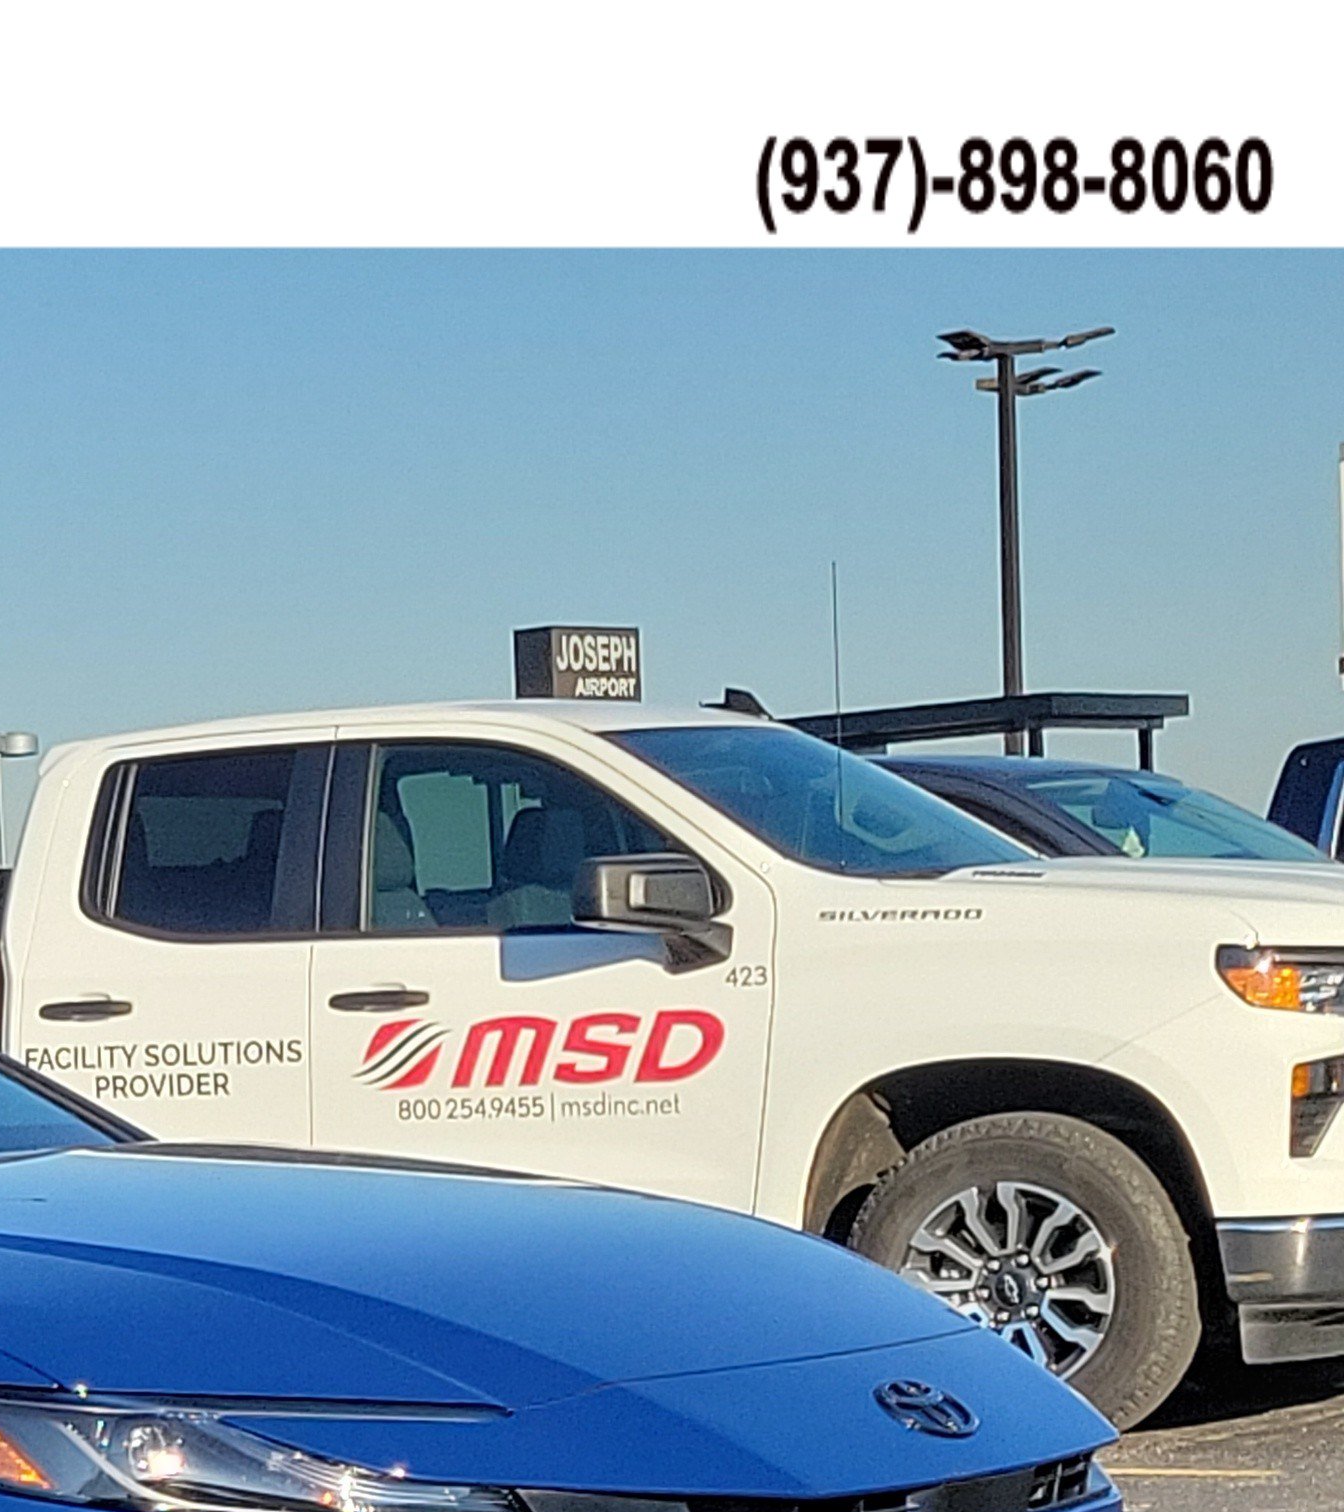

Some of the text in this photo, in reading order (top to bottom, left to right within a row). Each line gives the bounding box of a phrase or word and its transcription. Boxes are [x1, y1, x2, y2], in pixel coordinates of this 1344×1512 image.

[556, 634, 637, 672] JOSEPH
[574, 676, 637, 697] AIRPORT
[817, 908, 984, 922] SILVERADO
[725, 966, 769, 987] 423
[25, 1039, 303, 1071] FACILITY SOLUTIONS
[450, 1009, 725, 1089] MSD
[95, 1072, 231, 1100] PROVIDER
[398, 1098, 443, 1121] 800
[445, 1096, 545, 1120] 254.9455
[560, 1092, 682, 1118] msdinc.net
